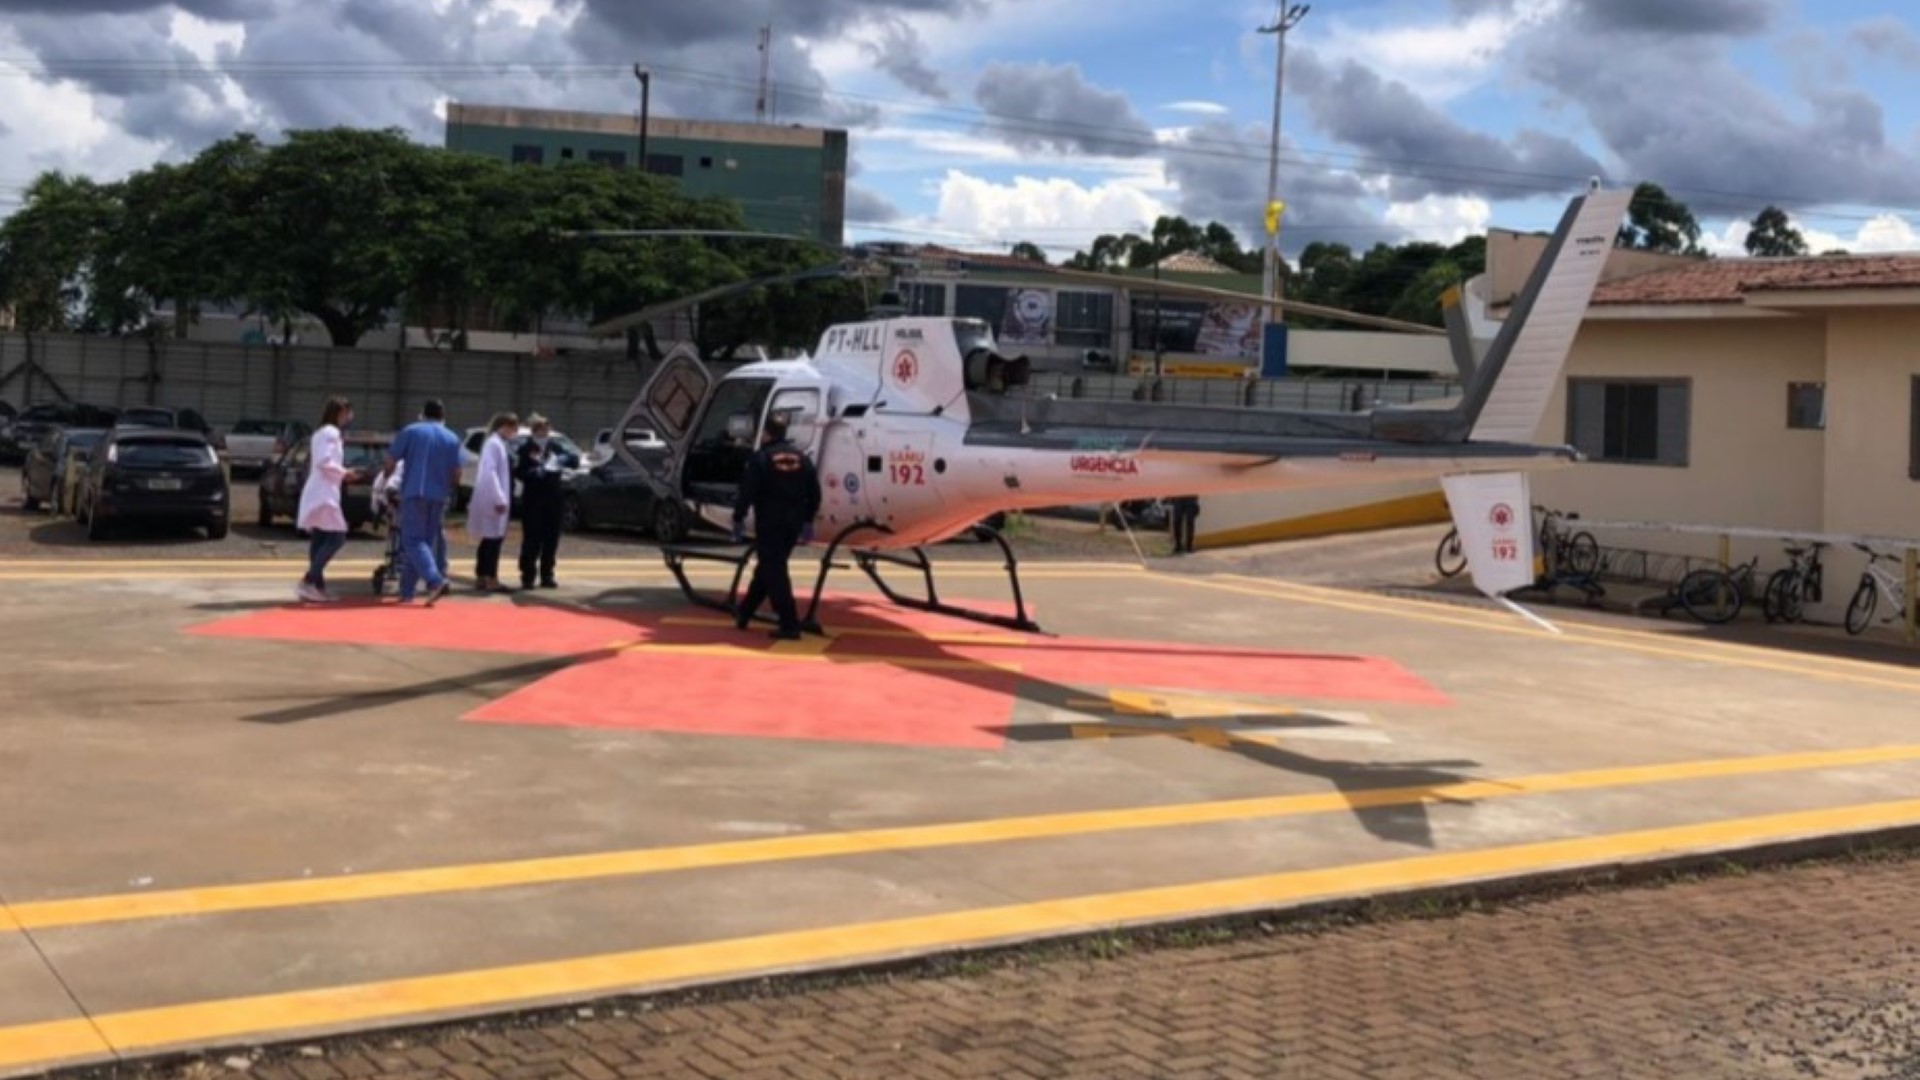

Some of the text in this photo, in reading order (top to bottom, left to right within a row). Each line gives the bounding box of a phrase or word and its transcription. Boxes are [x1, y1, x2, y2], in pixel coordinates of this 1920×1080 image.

[827, 326, 880, 352] PT-HLL
[889, 464, 925, 485] 192
[1492, 546, 1517, 560] 192
